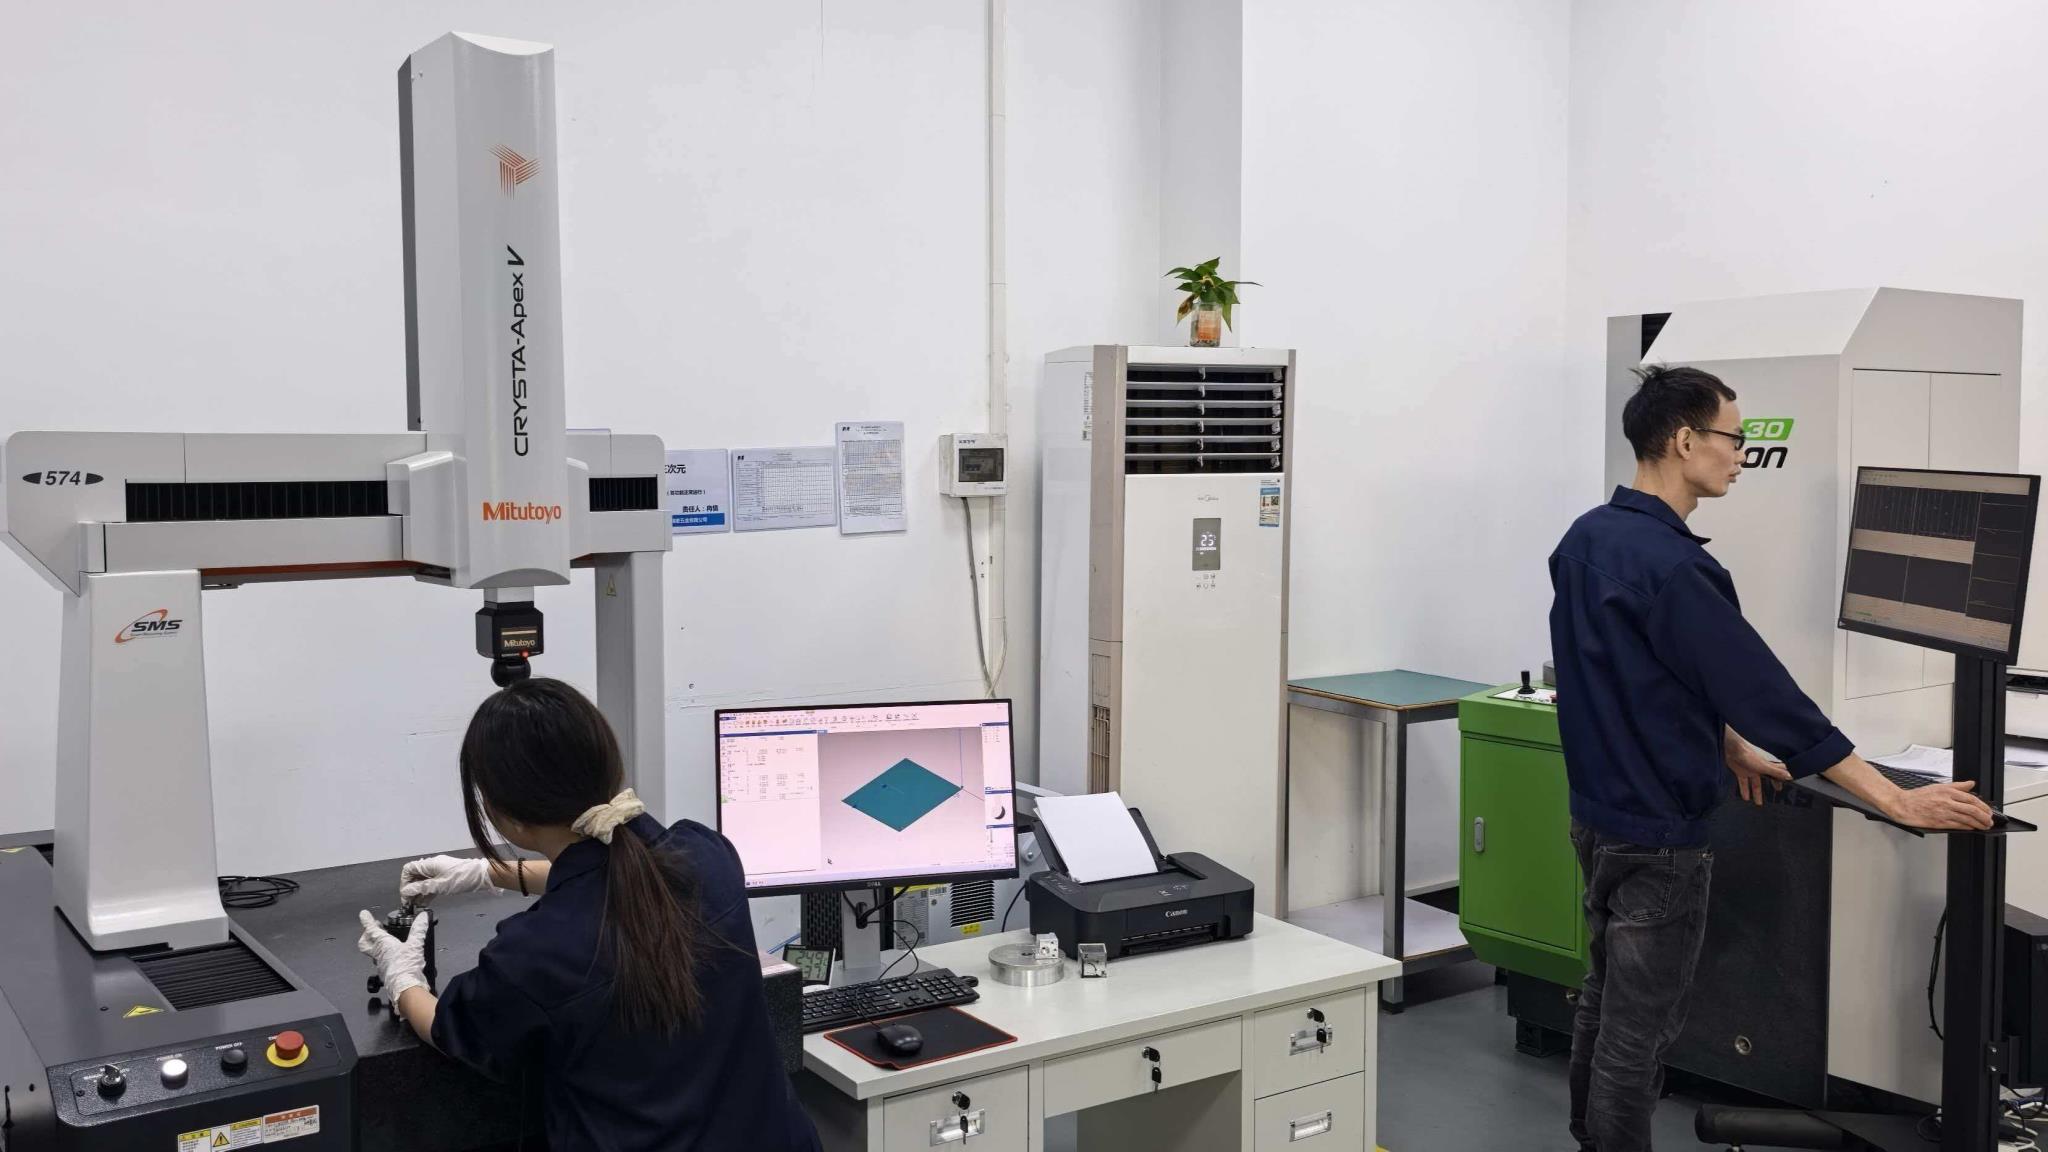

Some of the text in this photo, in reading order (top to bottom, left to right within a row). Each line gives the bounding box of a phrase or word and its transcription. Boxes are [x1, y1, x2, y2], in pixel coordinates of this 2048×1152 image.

[506, 244, 529, 457] CRYSTA-Apex V
[45, 470, 81, 486] 574
[482, 501, 562, 525] Mitutoyo
[131, 619, 183, 633] SMS
[503, 639, 536, 648] Mitutoyo
[1165, 909, 1188, 918] Canon
